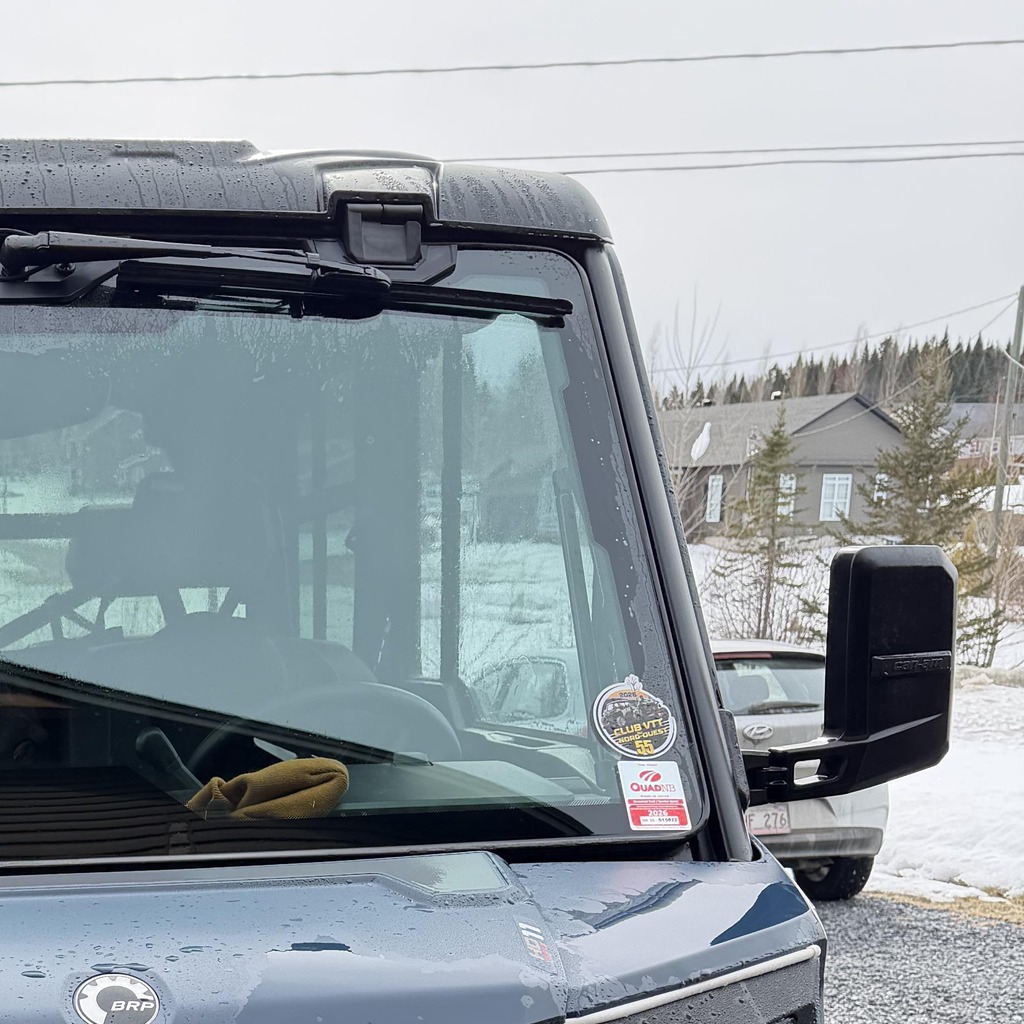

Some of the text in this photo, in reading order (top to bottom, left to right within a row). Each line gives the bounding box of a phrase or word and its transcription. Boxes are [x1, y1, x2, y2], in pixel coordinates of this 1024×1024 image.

[613, 723, 643, 737] CLUB
[643, 718, 663, 730] VTT
[618, 727, 668, 743] NORD-OUEST
[634, 739, 654, 755] 55
[763, 812, 787, 829] 276
[110, 1000, 155, 1012] BRP
